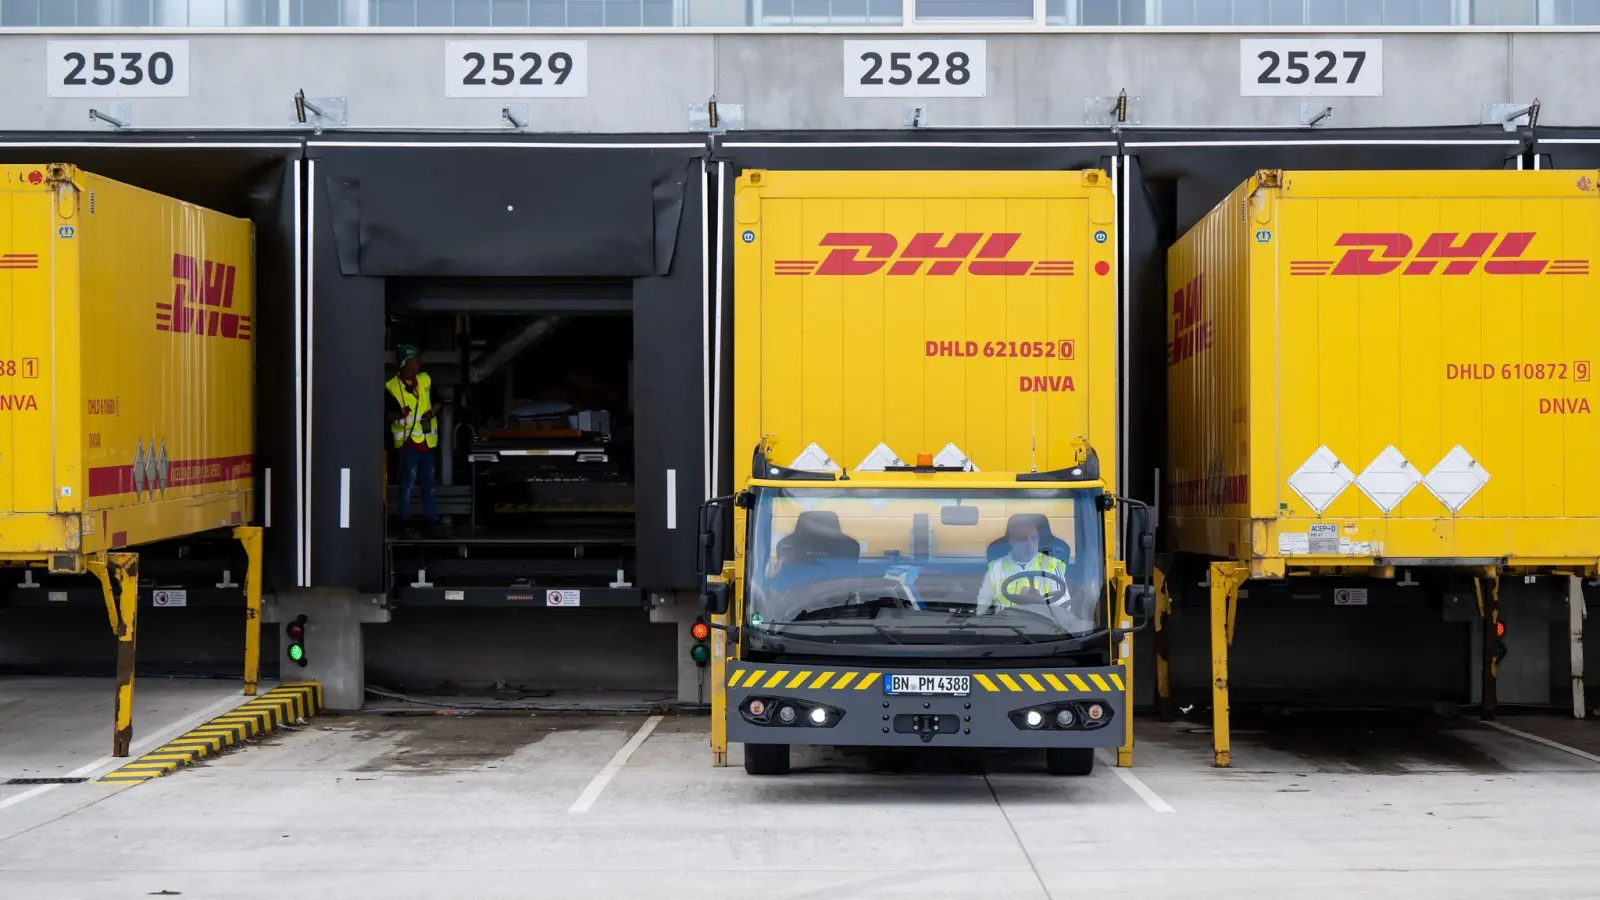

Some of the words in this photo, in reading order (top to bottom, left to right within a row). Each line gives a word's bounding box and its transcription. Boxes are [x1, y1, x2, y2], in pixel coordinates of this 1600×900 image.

[63, 52, 174, 85] 2530
[462, 52, 573, 85] 2529
[860, 51, 971, 85] 2528
[1257, 50, 1366, 84] 2527
[814, 232, 1035, 276] DHL
[1330, 232, 1549, 276] DHL
[170, 253, 240, 338] DHL
[925, 340, 979, 357] DHLD
[982, 340, 1056, 358] 621052
[1019, 376, 1075, 392] DNVA
[1446, 363, 1495, 379] DHLD
[1500, 363, 1568, 380] 610872
[1575, 362, 1588, 380] 9
[1539, 398, 1591, 414] DNVA
[893, 677, 909, 691] BN
[919, 677, 935, 691] PM
[938, 677, 969, 691] 4388
